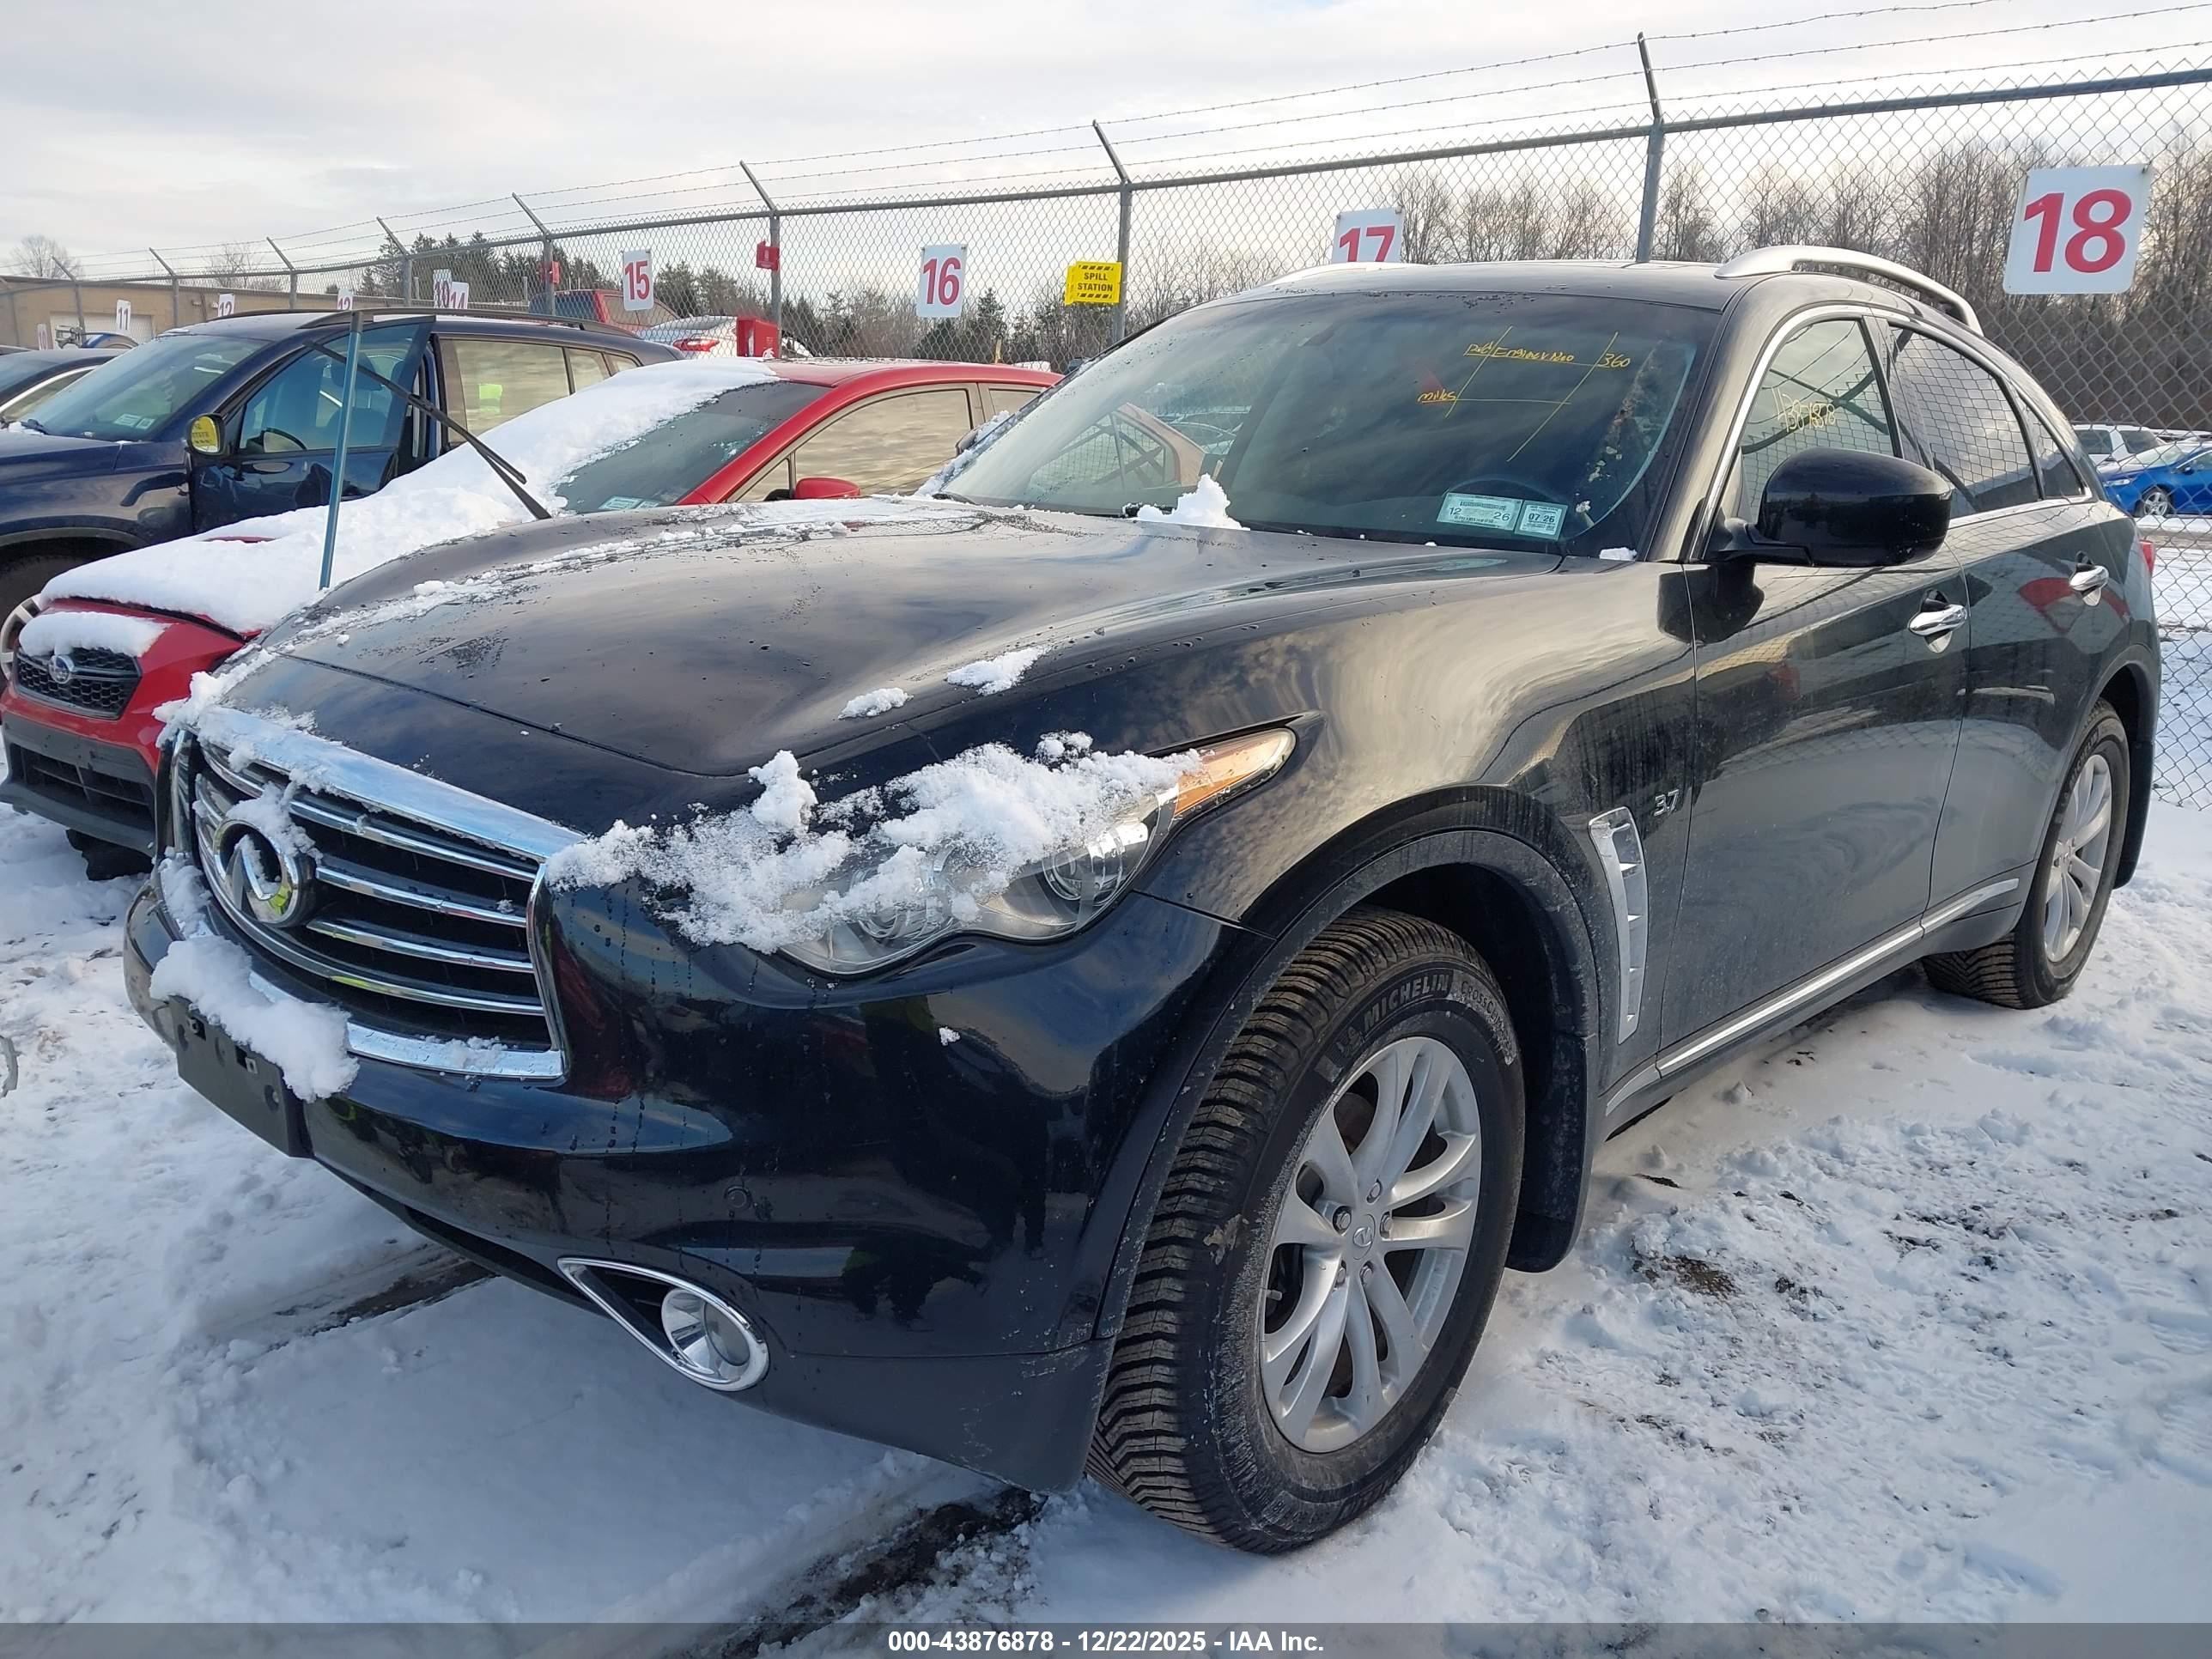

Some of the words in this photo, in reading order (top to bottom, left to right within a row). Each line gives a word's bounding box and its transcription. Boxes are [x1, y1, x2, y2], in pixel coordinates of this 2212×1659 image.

[2023, 188, 2133, 274] 18
[1339, 225, 1396, 262] 17
[624, 260, 650, 300] 15
[922, 257, 961, 306] 16
[1077, 283, 1113, 292] STATION
[1084, 272, 1108, 281] SPILL
[118, 307, 129, 331] 11
[1597, 352, 1632, 368] 360
[1449, 507, 1462, 515] 12
[1493, 511, 1510, 521] 26
[1528, 513, 1540, 521] 07
[1542, 514, 1555, 523] 26
[1363, 973, 1449, 1032] MICHELIN
